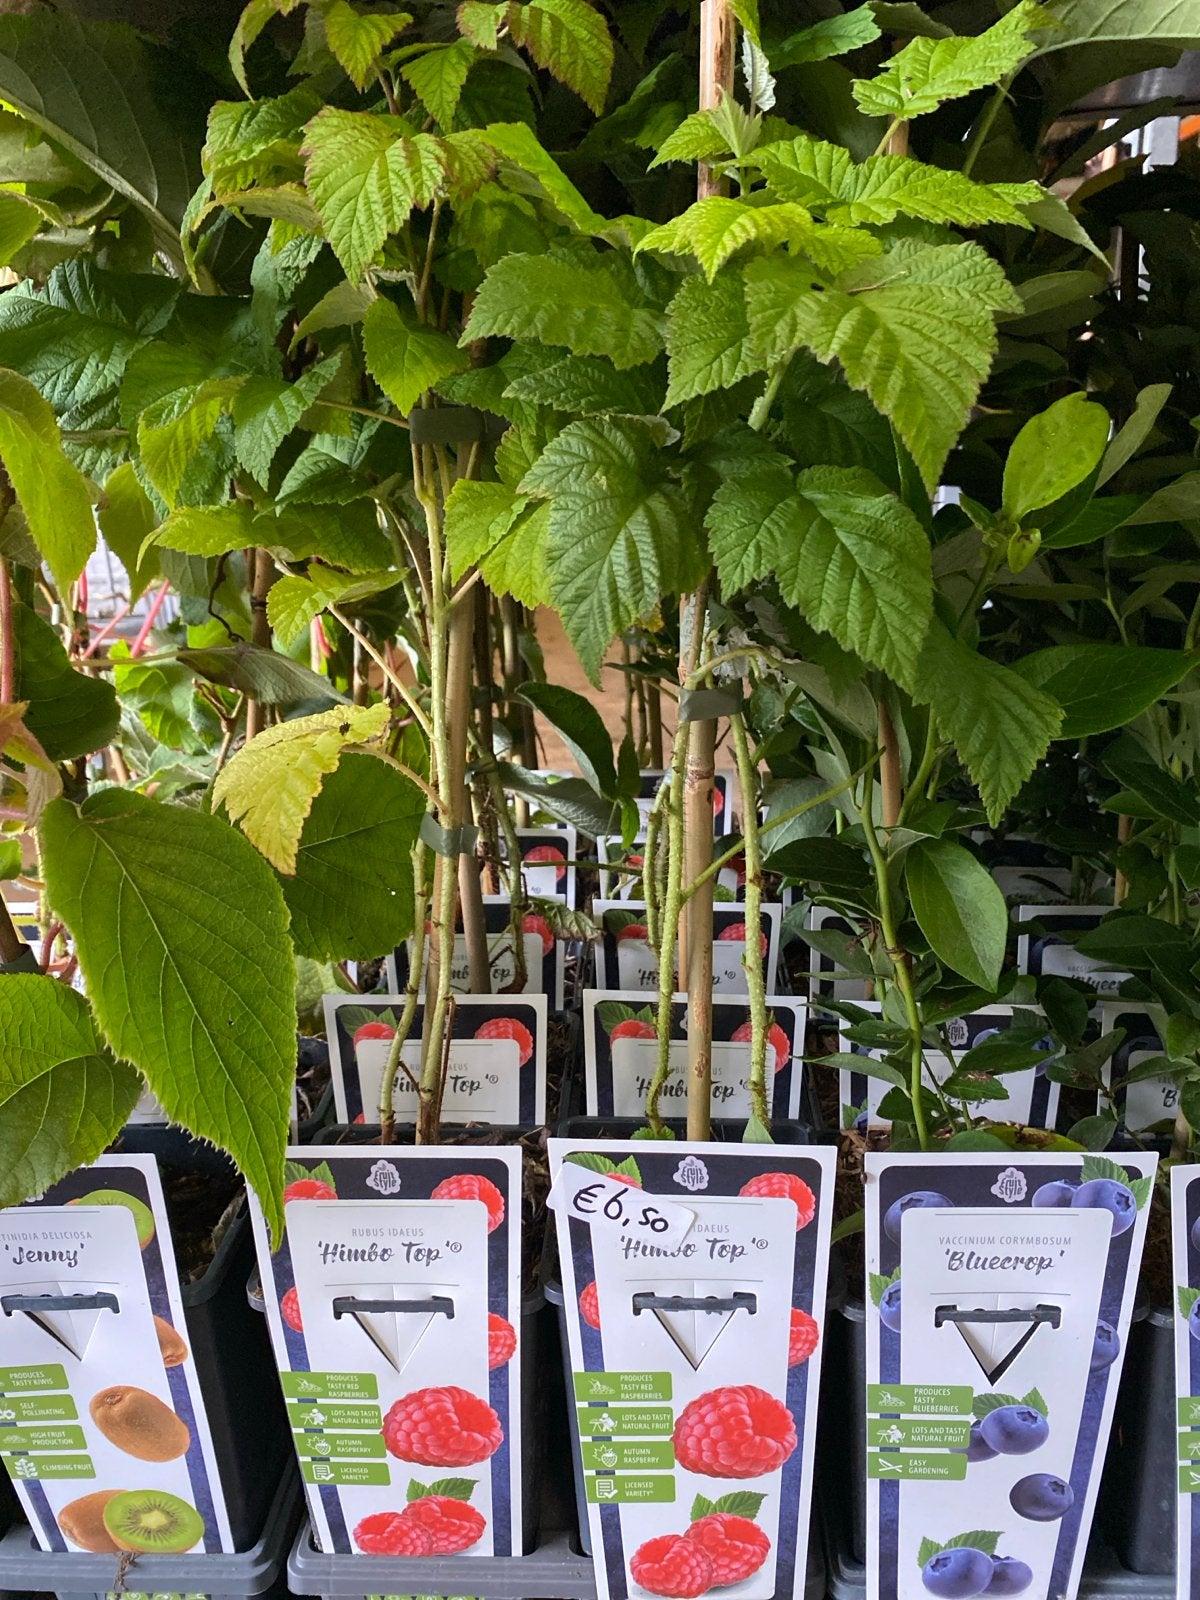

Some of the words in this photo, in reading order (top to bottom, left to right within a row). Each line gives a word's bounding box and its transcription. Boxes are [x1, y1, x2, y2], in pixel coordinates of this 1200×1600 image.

[375, 1169, 396, 1181] Fruit
[682, 1165, 703, 1176] Fruit
[373, 1178, 397, 1191] Style
[681, 1174, 704, 1187] Style
[1001, 1177, 1022, 1187] Fruit
[999, 1186, 1023, 1198] Style
[572, 1183, 669, 1233] €6,50
[352, 1228, 385, 1237] RUBUS
[389, 1228, 424, 1237] IDAEUS
[692, 1224, 730, 1233] IDAEUS
[42, 1231, 93, 1240] DELICIOSA
[939, 1236, 995, 1245] VACCINIUM
[1000, 1236, 1072, 1245] CORYMBOSUM
[5, 1242, 84, 1268] 'Jenny'
[318, 1240, 394, 1265] 'Himbo
[945, 1248, 1065, 1276] 'Bluecrop'
[9, 1371, 45, 1380] PRODUCES
[326, 1374, 359, 1382] PRODUCES
[620, 1374, 653, 1382] PRODUCES
[11, 1379, 31, 1387] TASTY
[34, 1378, 54, 1386] KIWIS
[620, 1383, 639, 1391] TASTY
[640, 1383, 653, 1391] RED
[620, 1392, 663, 1400] RASPBERRIES
[914, 1388, 951, 1396] PRODUCES
[914, 1396, 936, 1404] TASTY
[23, 1408, 65, 1417] POLLINATING
[912, 1404, 959, 1413] BLUEBERRIES
[622, 1422, 650, 1430] NATURAL
[651, 1422, 670, 1430] FRUIT
[911, 1426, 928, 1434] LOTS
[945, 1427, 967, 1435] TASTY
[32, 1438, 74, 1446] PRODUCTION
[944, 1435, 965, 1443] FRUIT
[623, 1456, 660, 1464] RASPBERRY
[909, 1459, 927, 1467] EASY
[42, 1464, 73, 1472] CLIMBING
[73, 1463, 92, 1471] FRUIT
[908, 1467, 949, 1475] GARDENING
[624, 1481, 654, 1489] LICENSED
